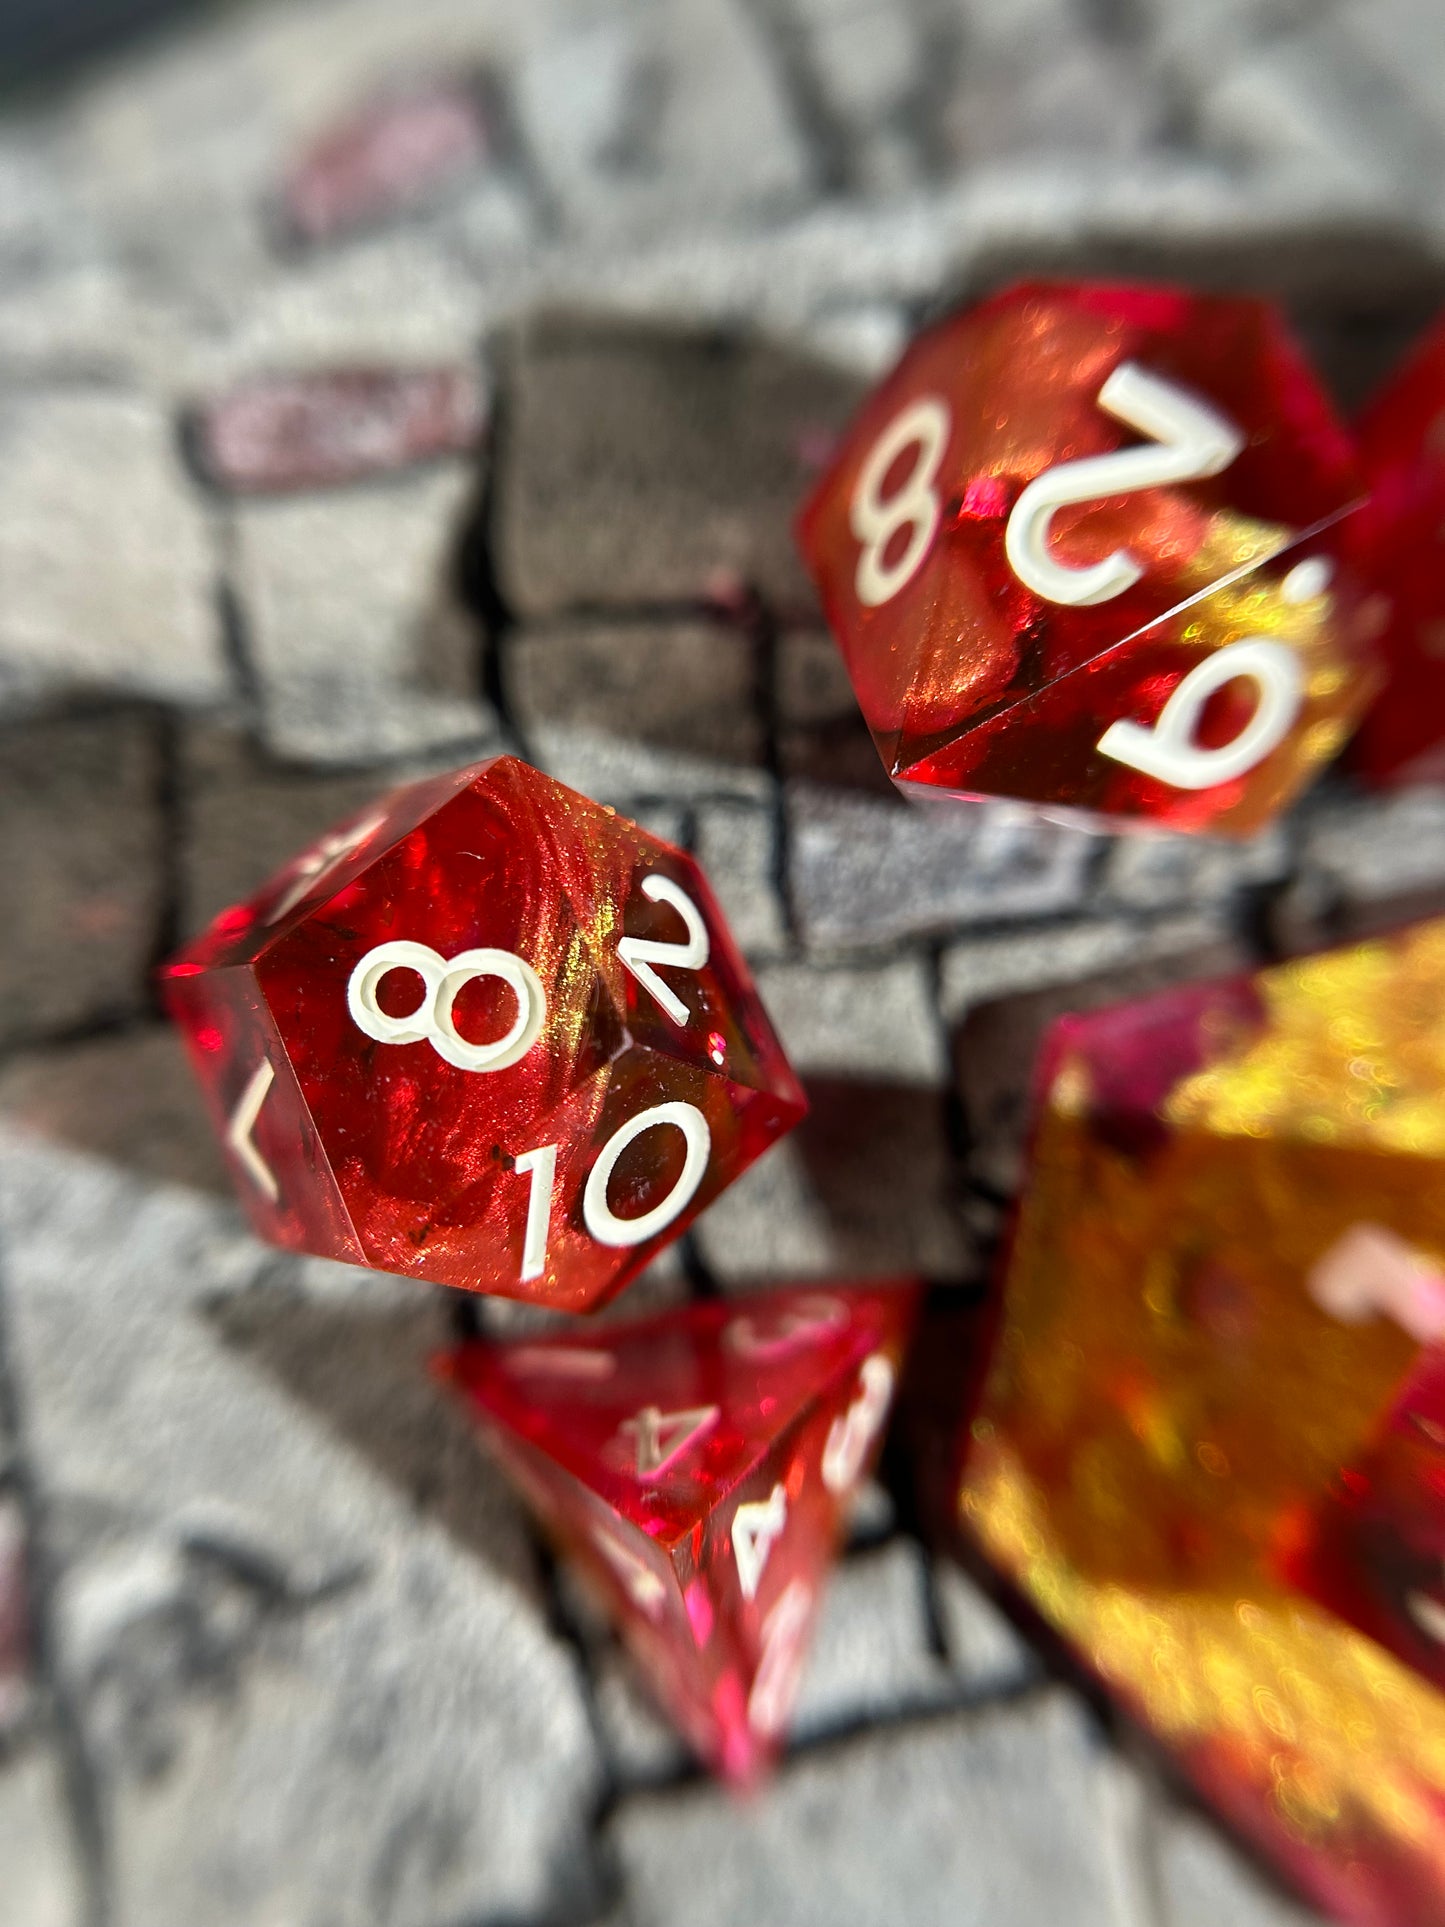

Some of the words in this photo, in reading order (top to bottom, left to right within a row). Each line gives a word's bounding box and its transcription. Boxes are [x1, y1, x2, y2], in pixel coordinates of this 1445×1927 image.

[850, 397, 951, 607] 8
[1005, 361, 1243, 606] 2
[347, 940, 547, 1072] 8
[616, 873, 710, 1027] 2
[515, 1101, 711, 1282] 10
